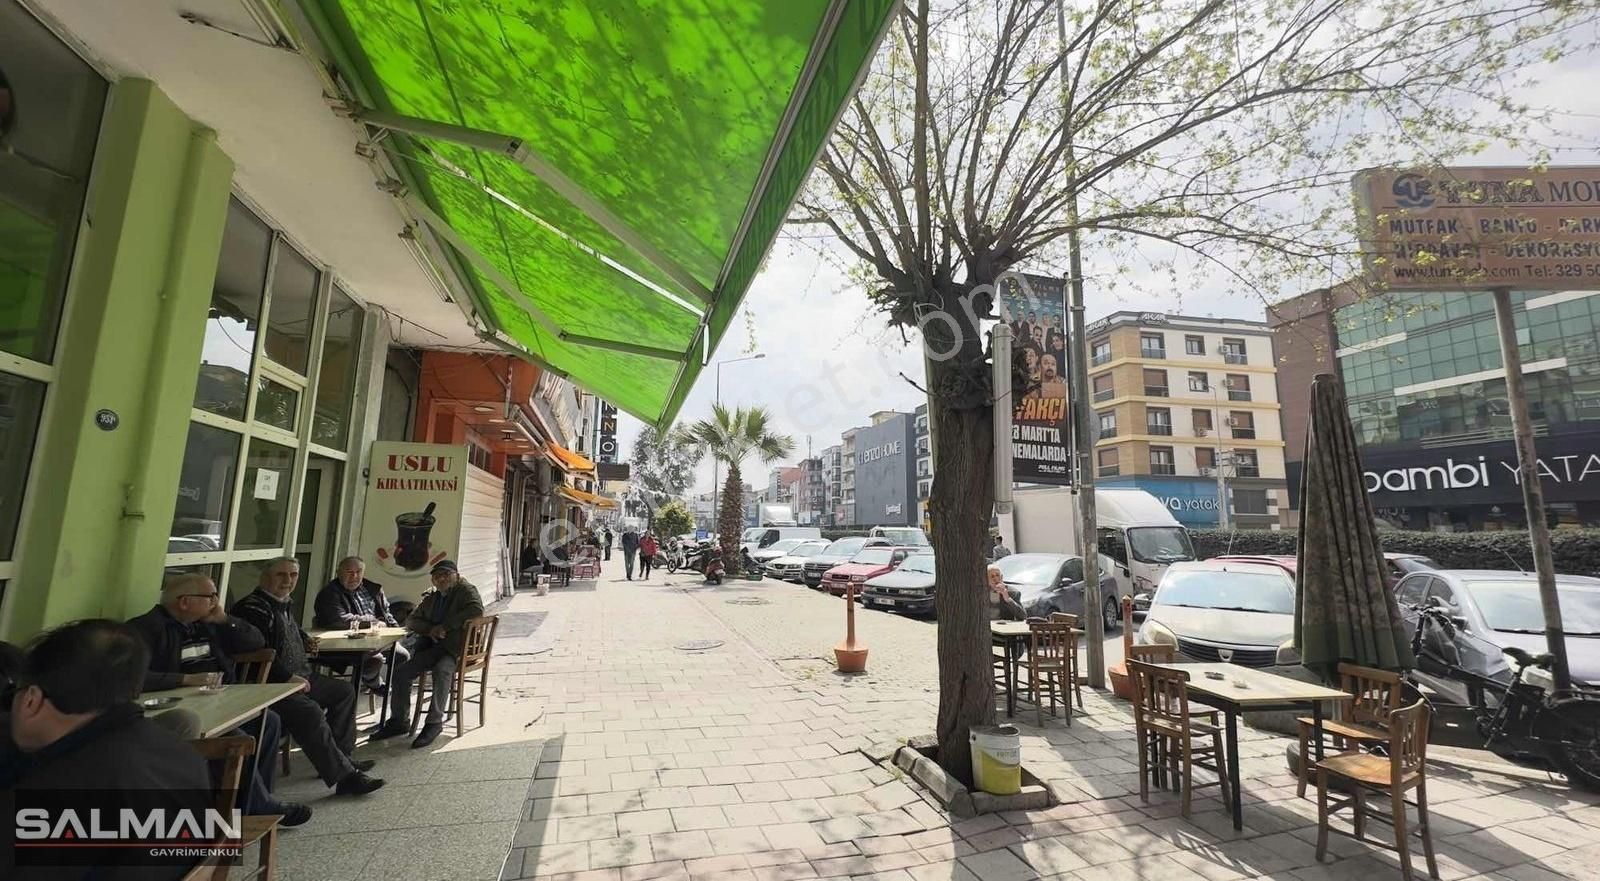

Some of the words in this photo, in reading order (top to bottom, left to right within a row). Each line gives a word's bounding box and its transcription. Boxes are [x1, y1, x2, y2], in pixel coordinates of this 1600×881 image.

[1390, 219, 1458, 234] MUTFAK
[1480, 218, 1537, 234] BANYO
[1524, 265, 1552, 277] Tel:
[1555, 265, 1582, 277] 329
[1011, 424, 1020, 440] 8
[1021, 425, 1061, 443] MART'TA
[387, 454, 455, 473] USLU
[376, 476, 458, 492] KIRAATHANESİ
[1184, 497, 1220, 511] yatak
